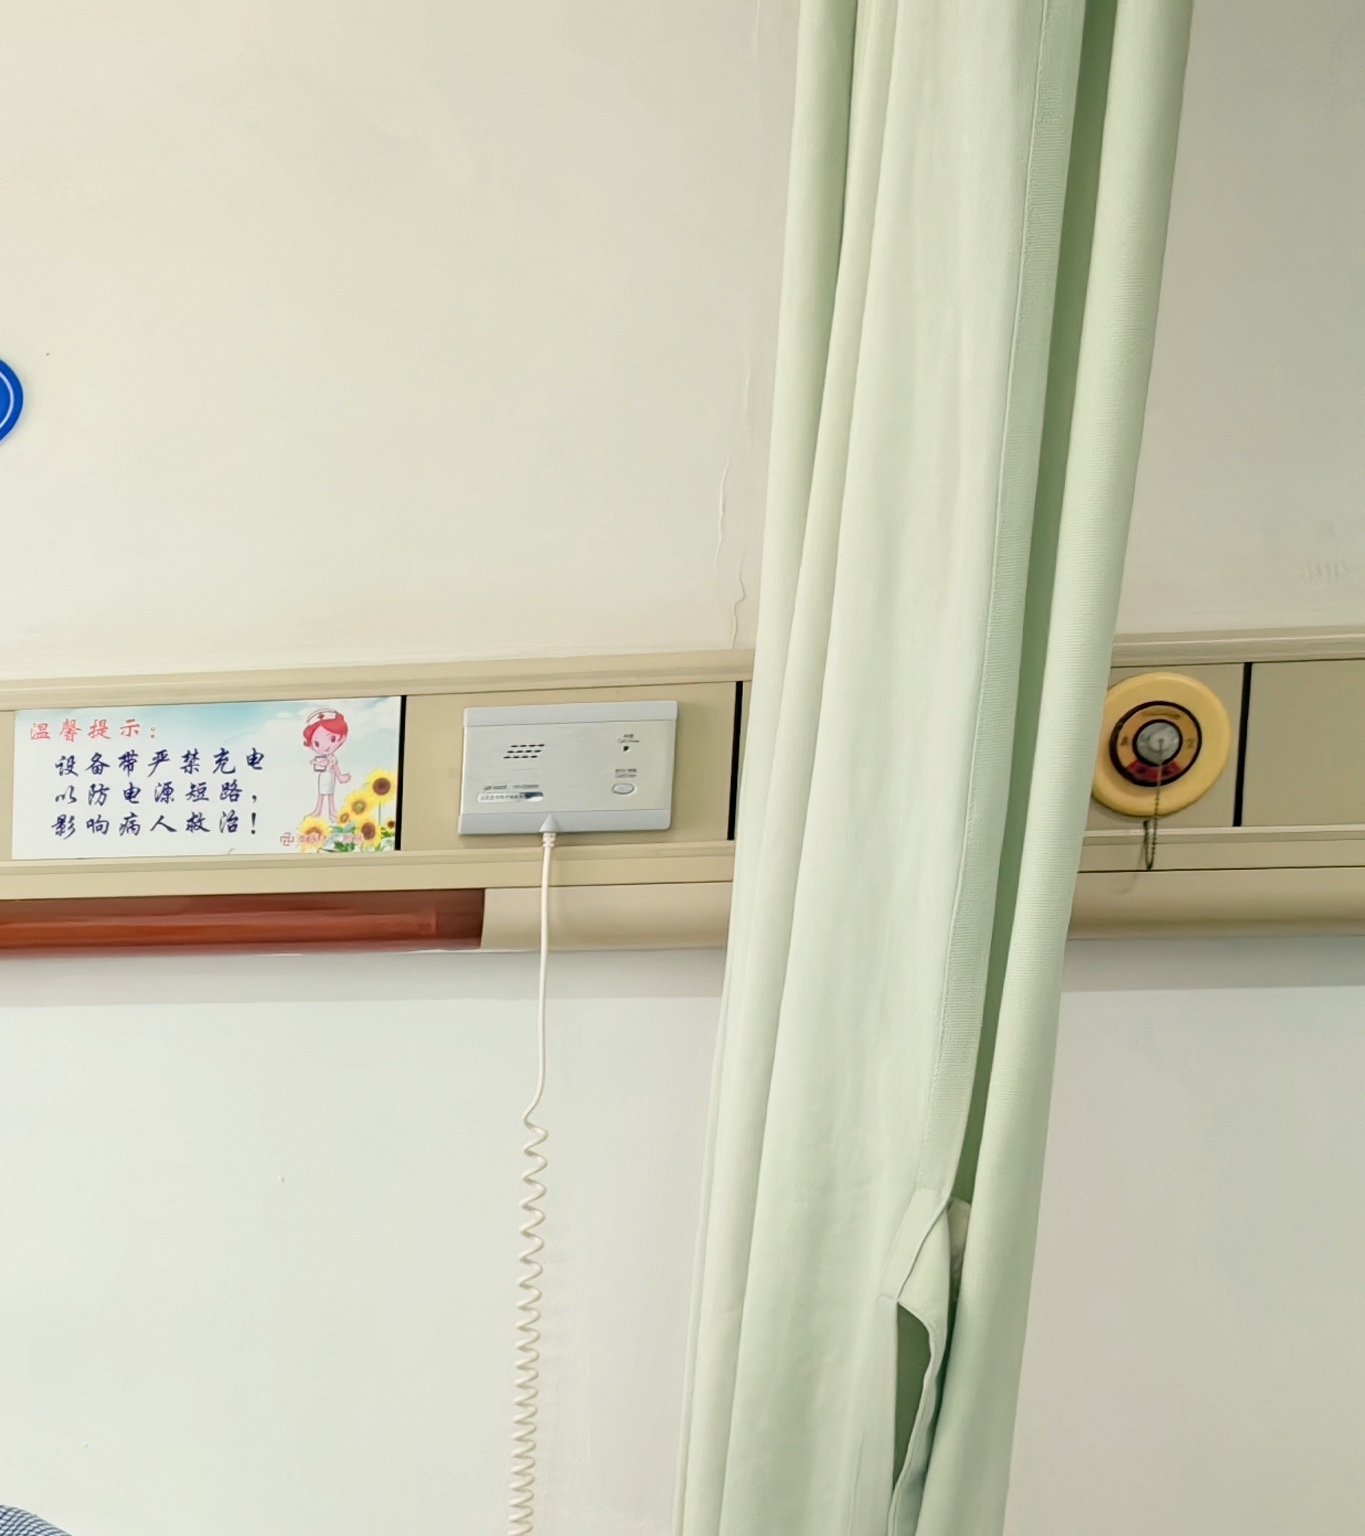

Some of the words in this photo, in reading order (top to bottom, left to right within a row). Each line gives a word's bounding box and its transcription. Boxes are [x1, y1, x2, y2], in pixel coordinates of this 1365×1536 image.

[54, 748, 265, 778] 设备带严禁充电
